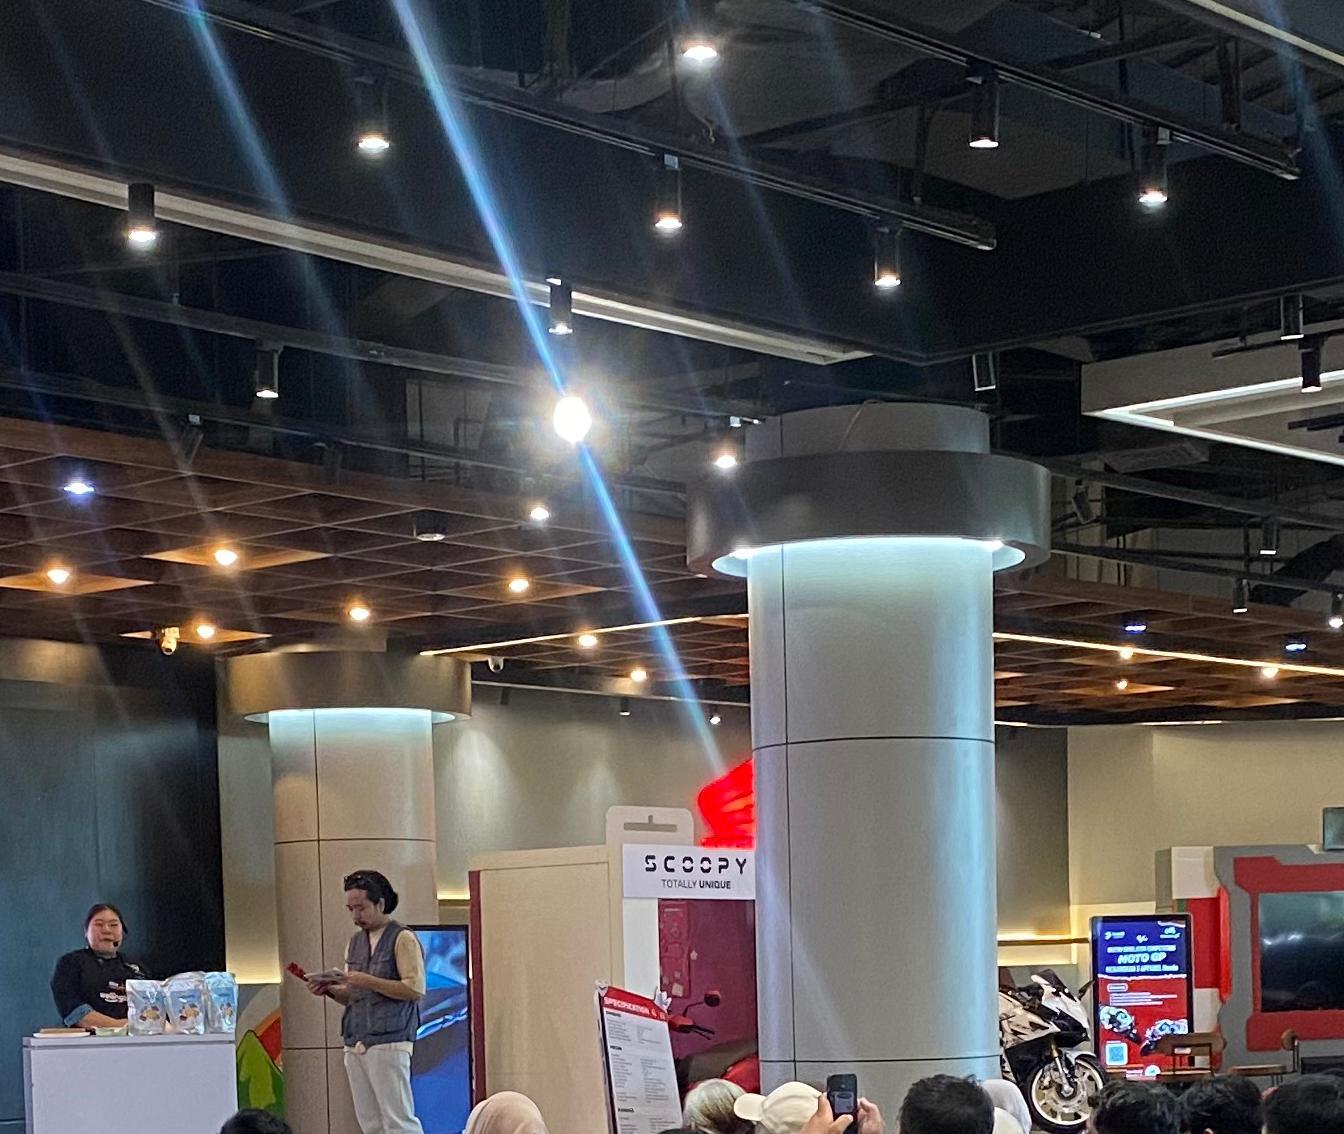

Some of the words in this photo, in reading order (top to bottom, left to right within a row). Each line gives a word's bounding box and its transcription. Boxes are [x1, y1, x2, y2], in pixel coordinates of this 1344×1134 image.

[644, 854, 747, 875] SCOOPY
[661, 878, 698, 889] TOTALLY
[698, 880, 731, 889] UNIQUE
[1117, 952, 1150, 965] MOTO
